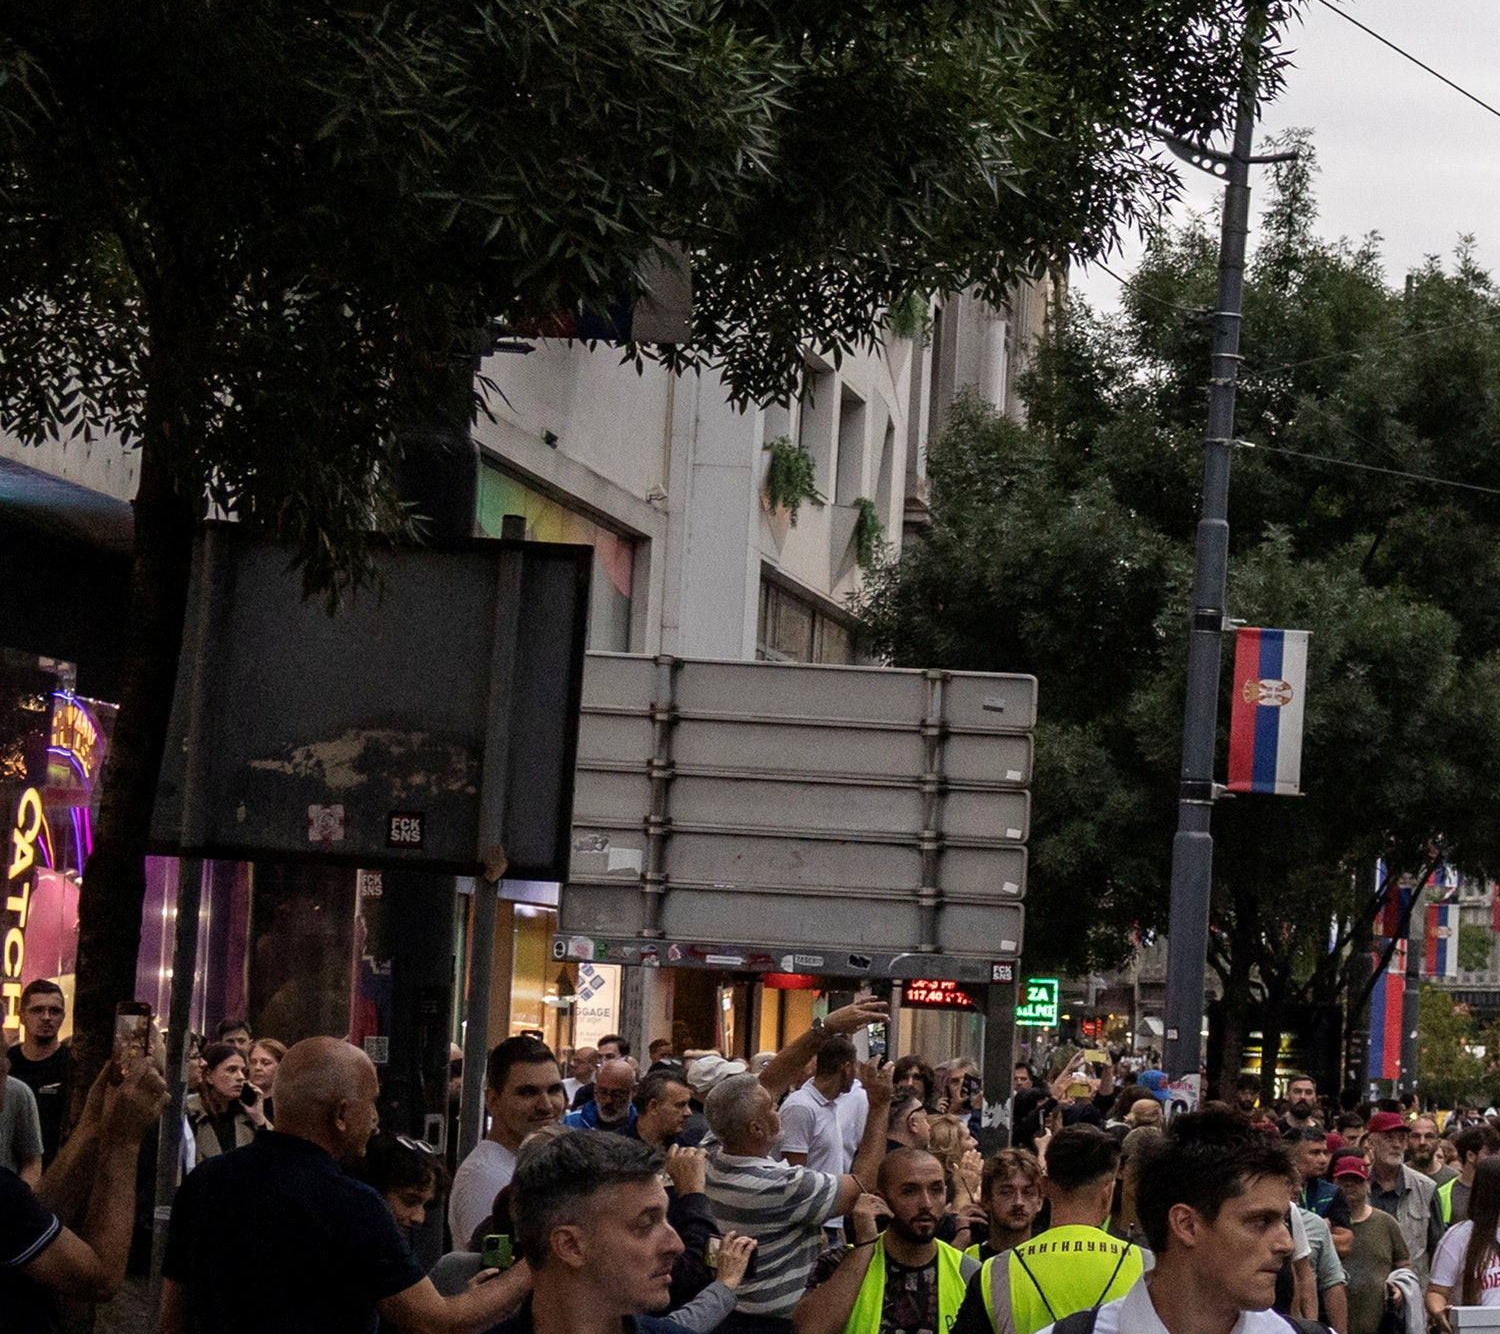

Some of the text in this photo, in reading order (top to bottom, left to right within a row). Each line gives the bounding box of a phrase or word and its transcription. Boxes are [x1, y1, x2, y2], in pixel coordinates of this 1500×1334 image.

[391, 817, 420, 832] FCK
[390, 829, 421, 842] SNS
[360, 873, 382, 886] FCK
[360, 885, 383, 896] SNS
[4, 787, 42, 1029] CATCH
